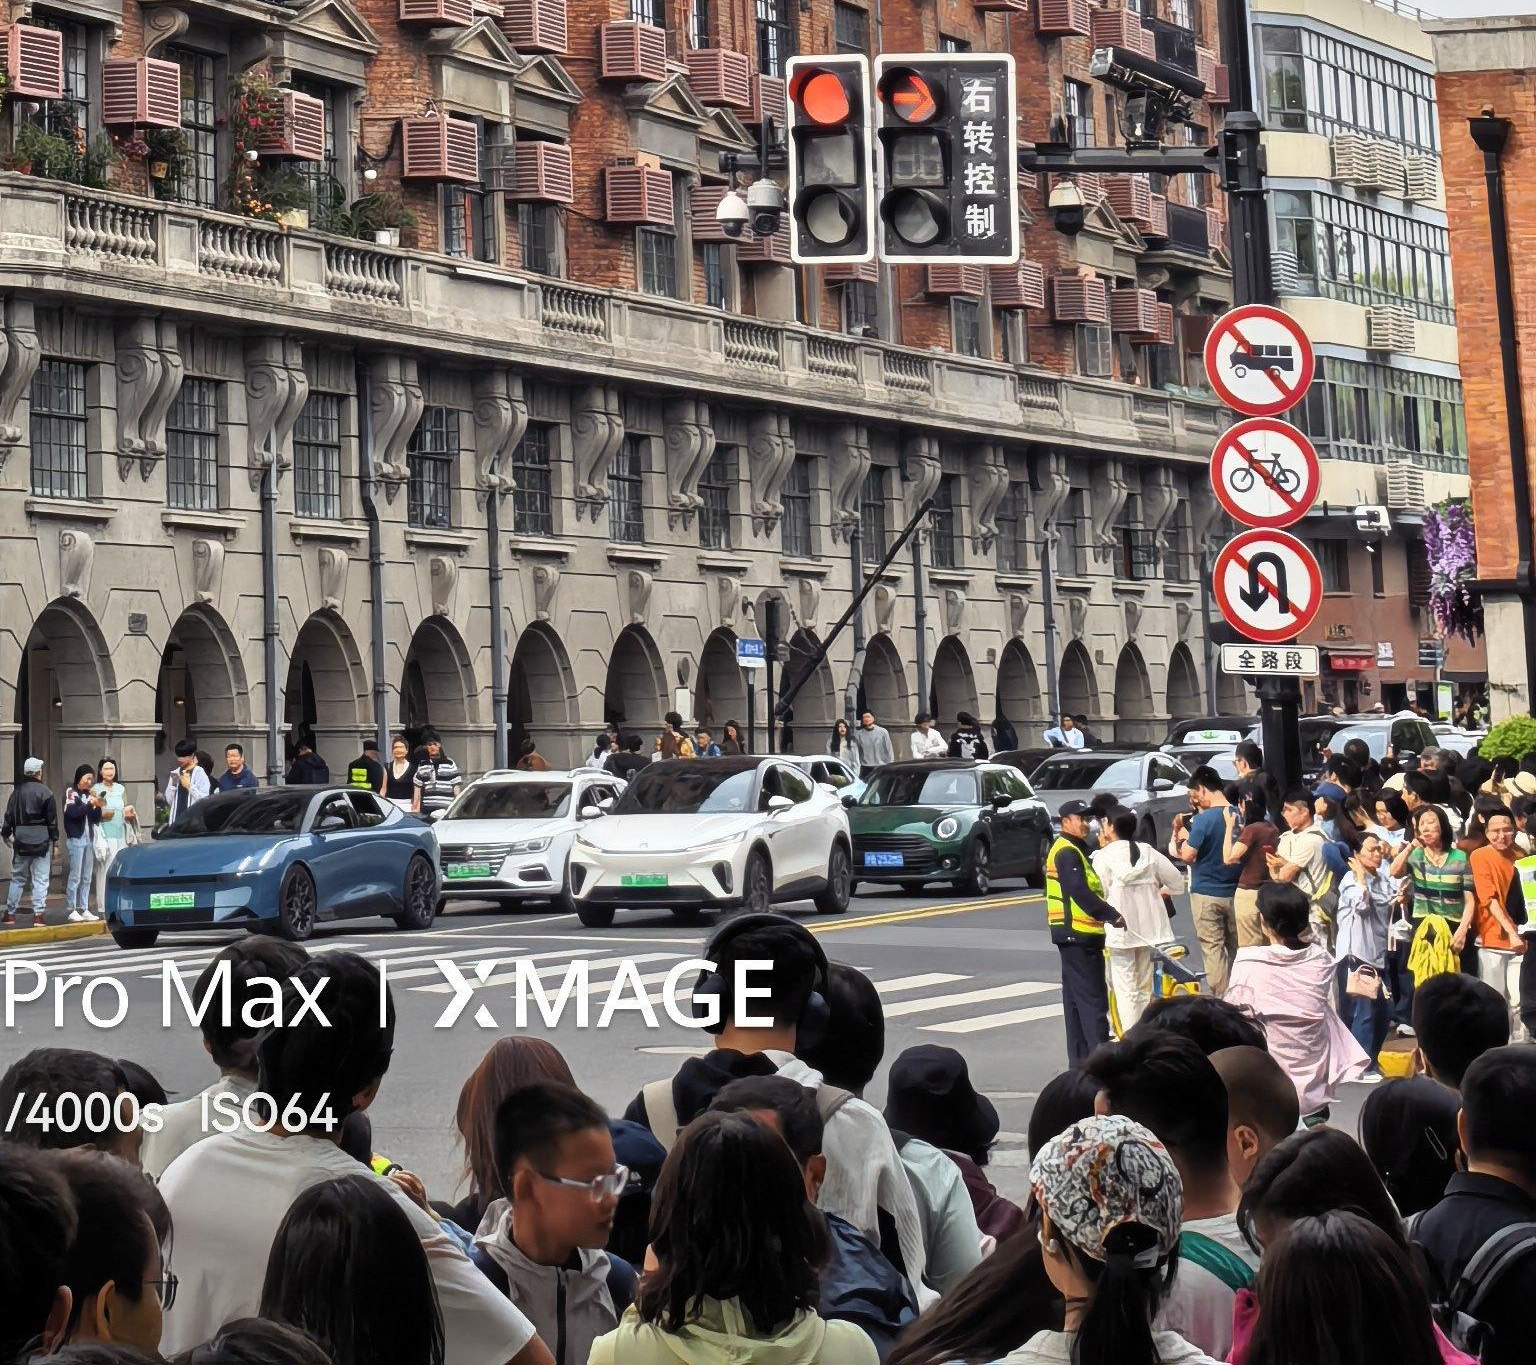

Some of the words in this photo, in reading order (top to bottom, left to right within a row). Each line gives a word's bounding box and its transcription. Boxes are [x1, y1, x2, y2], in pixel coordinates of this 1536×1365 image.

[962, 78, 997, 238] 右转控制
[1238, 649, 1303, 670] 全路段
